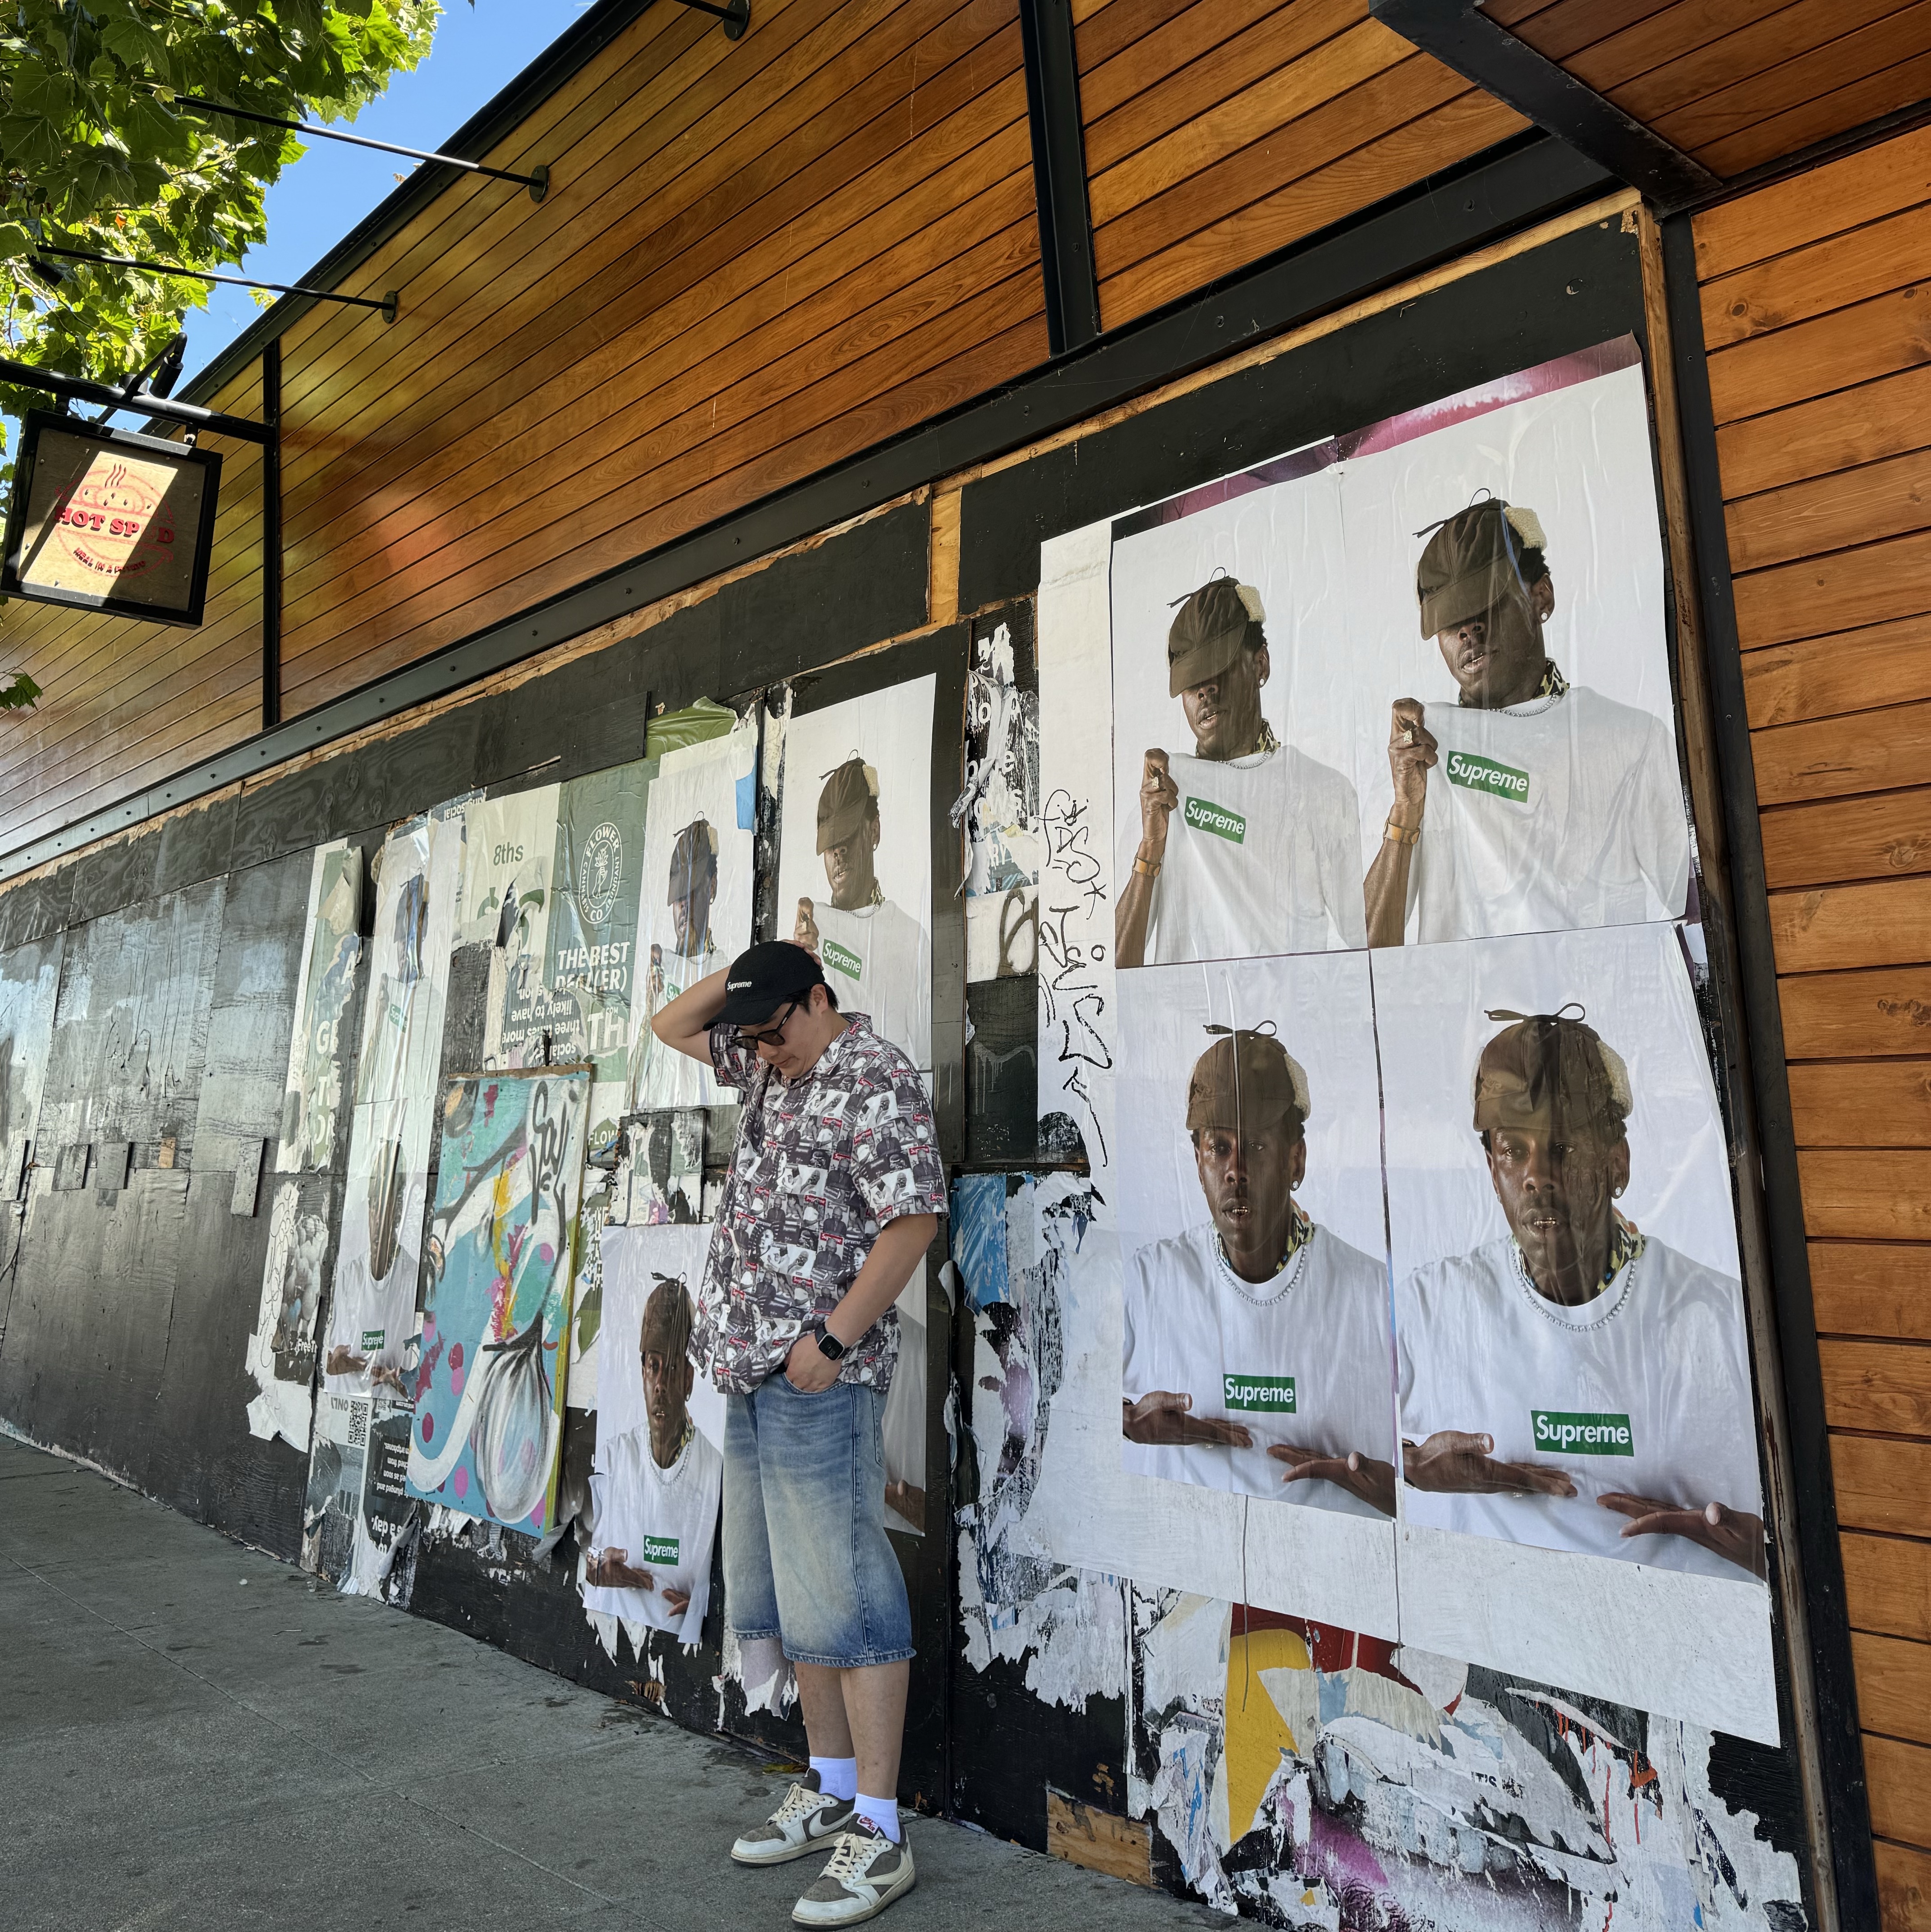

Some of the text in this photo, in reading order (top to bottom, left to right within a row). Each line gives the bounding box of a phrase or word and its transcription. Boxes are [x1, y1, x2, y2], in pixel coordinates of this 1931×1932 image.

[55, 505, 105, 530] HOT
[1449, 755, 1527, 792] Supreme
[1186, 800, 1244, 834] Supreme
[493, 842, 523, 866] 8ths
[586, 826, 620, 858] FLOWER
[590, 909, 603, 921] CO
[558, 941, 630, 970] THE BEST
[823, 942, 861, 973] Supreme
[727, 981, 752, 991] Supreme
[555, 1019, 580, 1035] three
[1225, 1377, 1294, 1407] Supreme
[1537, 1415, 1629, 1449] Supreme
[645, 1538, 678, 1560] Supreme
